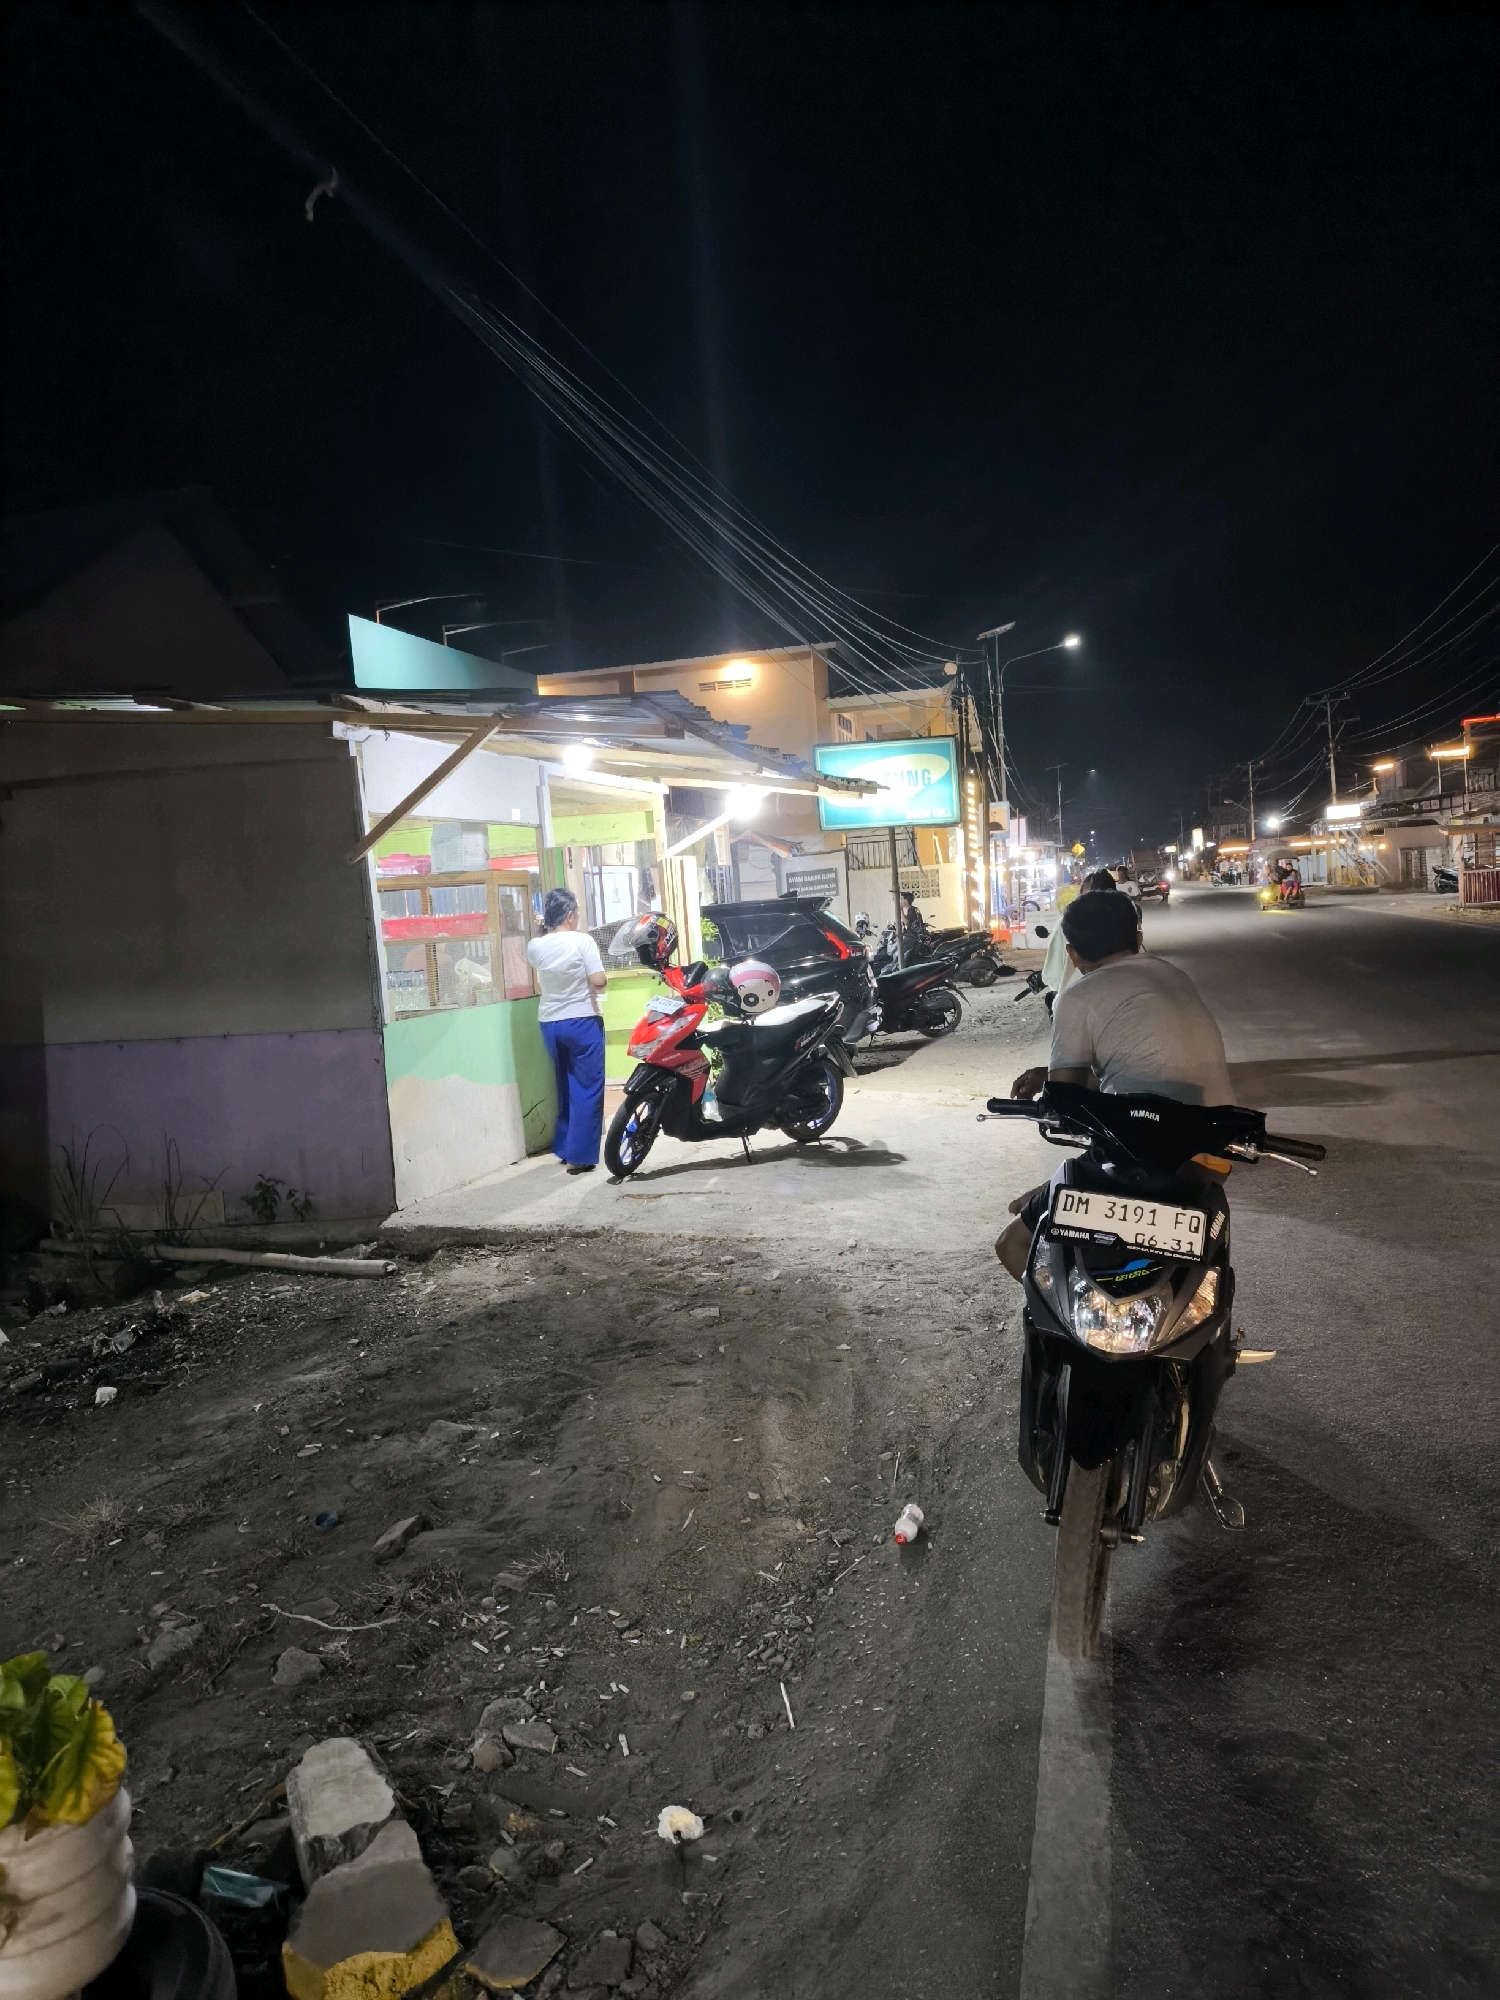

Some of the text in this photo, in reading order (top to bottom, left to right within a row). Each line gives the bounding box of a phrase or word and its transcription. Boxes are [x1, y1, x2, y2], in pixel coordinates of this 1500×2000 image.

[1129, 1109, 1160, 1122] YAMAHA
[1062, 1193, 1201, 1234] DM 3191 FQ
[1060, 1229, 1090, 1241] YAMAHA
